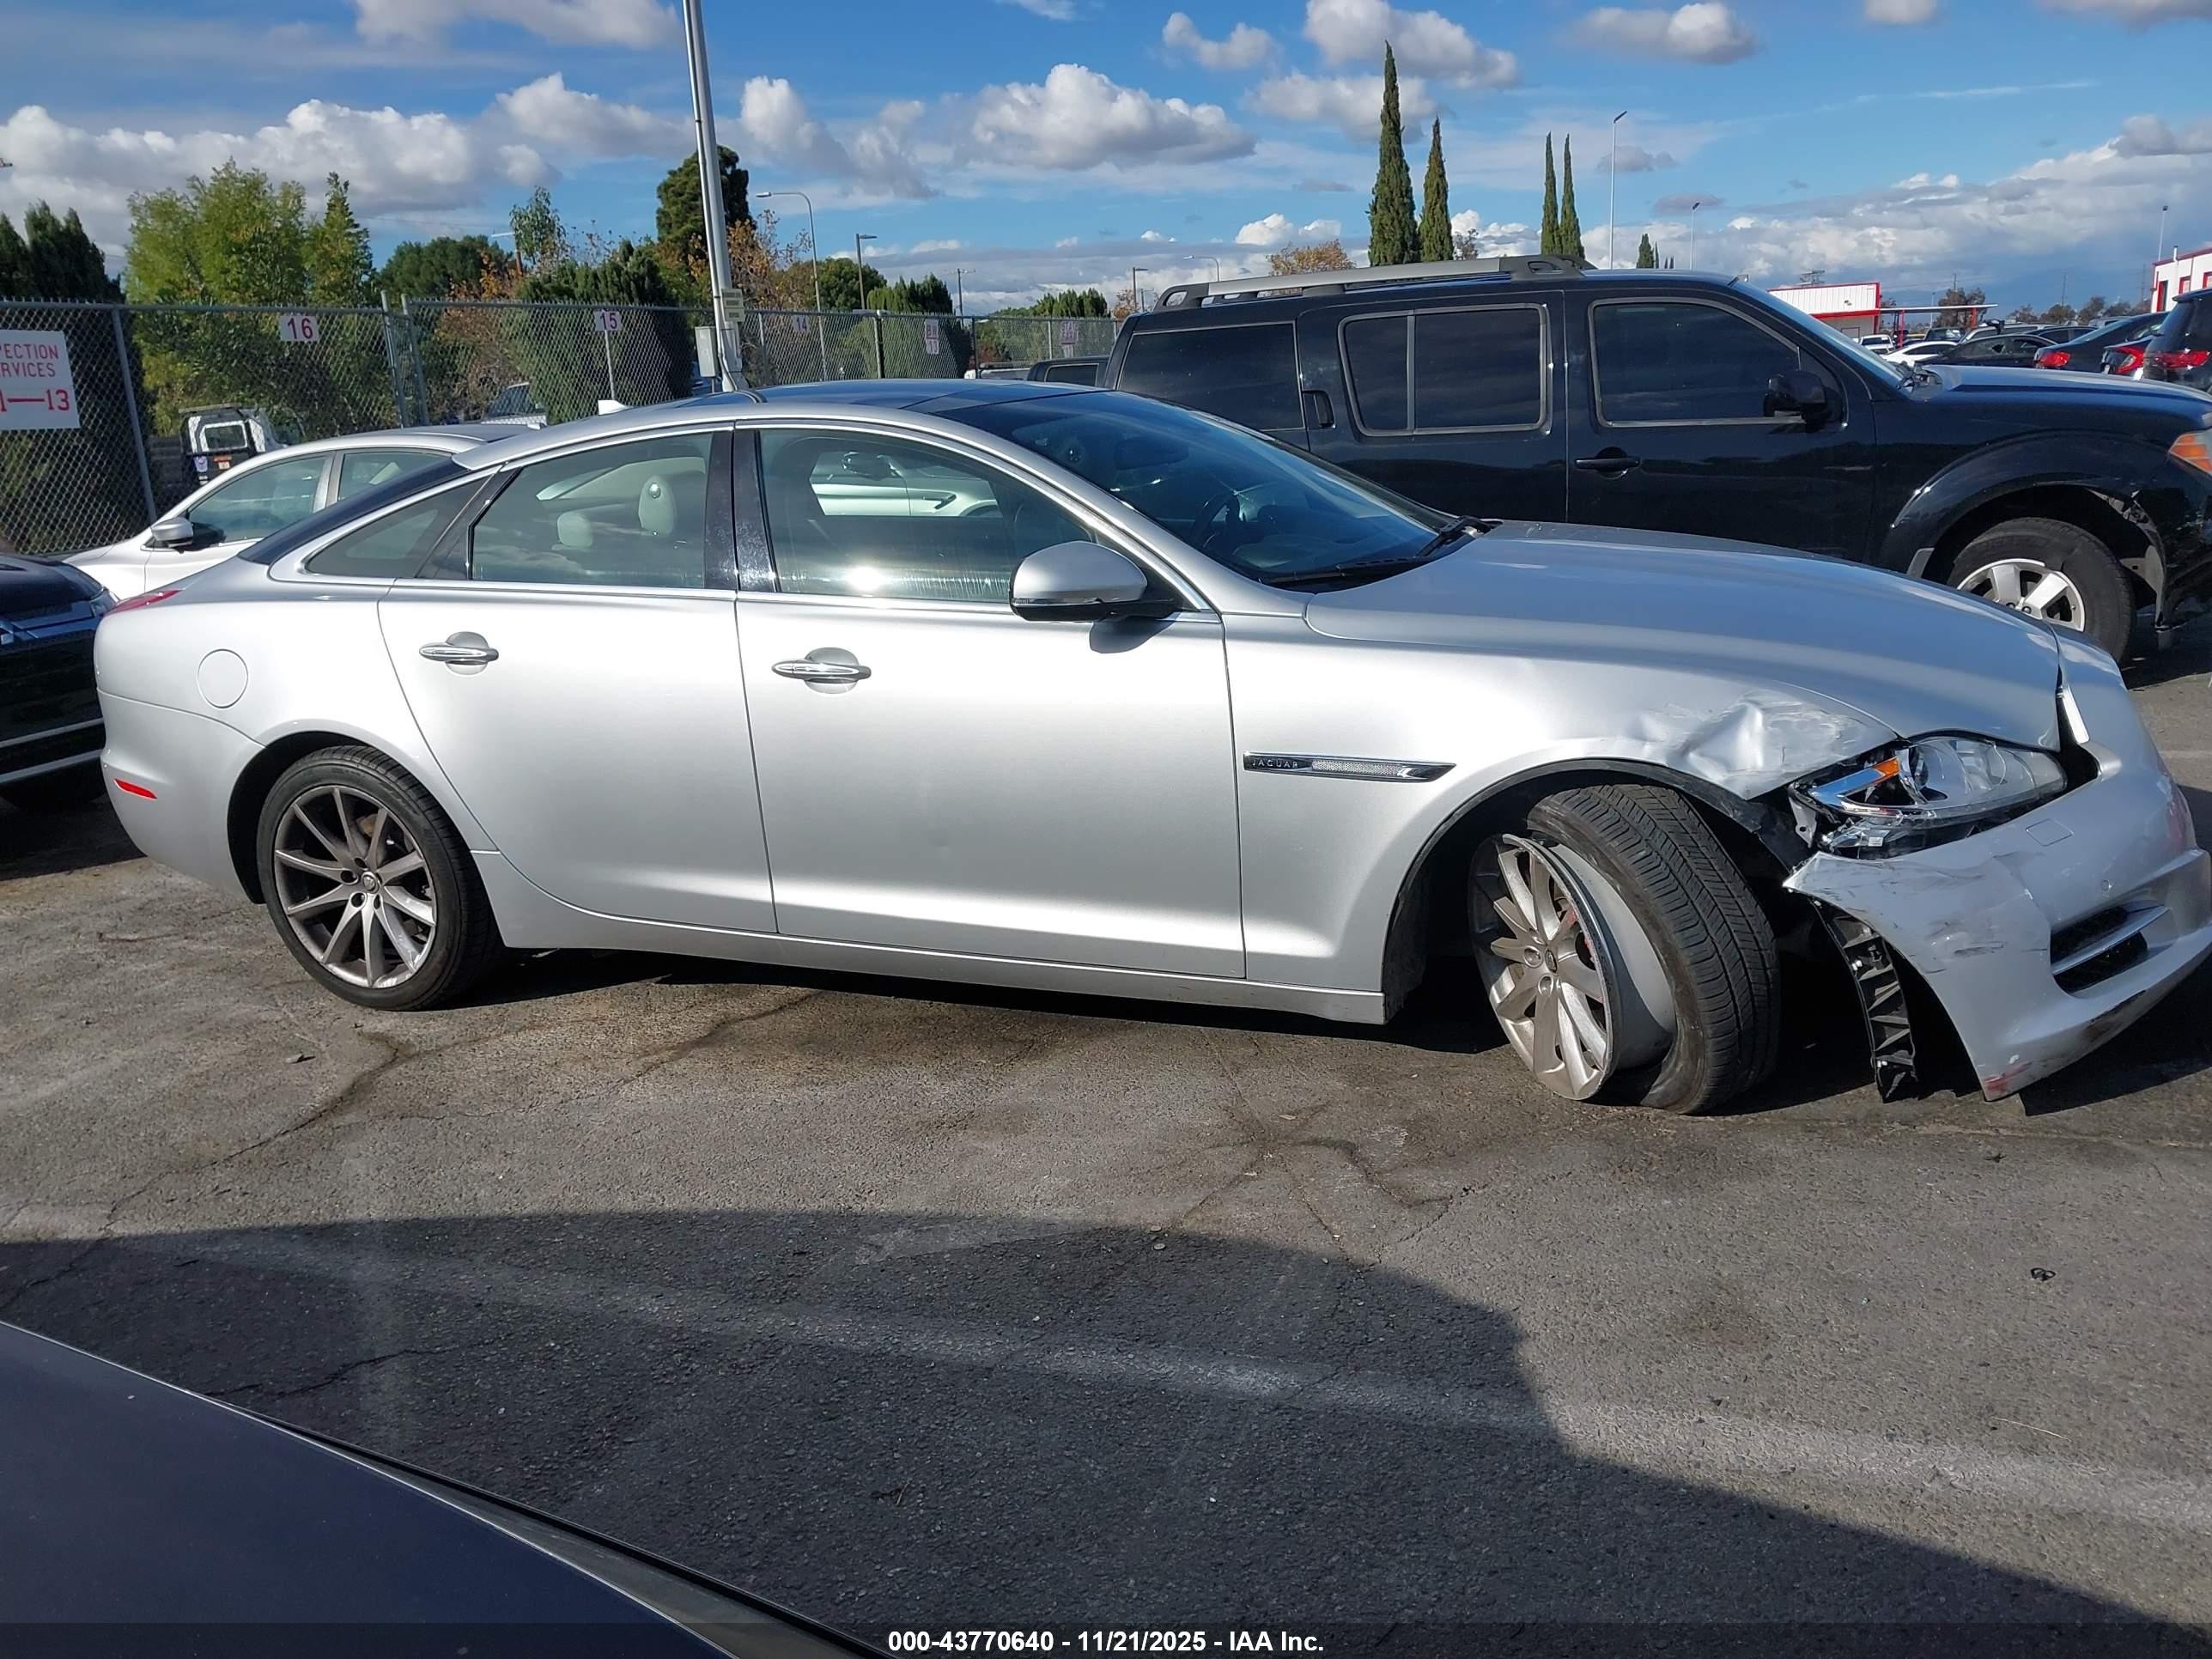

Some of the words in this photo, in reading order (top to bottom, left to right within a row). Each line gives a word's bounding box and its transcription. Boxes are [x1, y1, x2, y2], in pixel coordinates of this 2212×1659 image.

[288, 317, 313, 340] 16
[600, 312, 617, 330] 15
[0, 343, 59, 359] ECTION
[1253, 759, 1298, 768] JAGUAR
